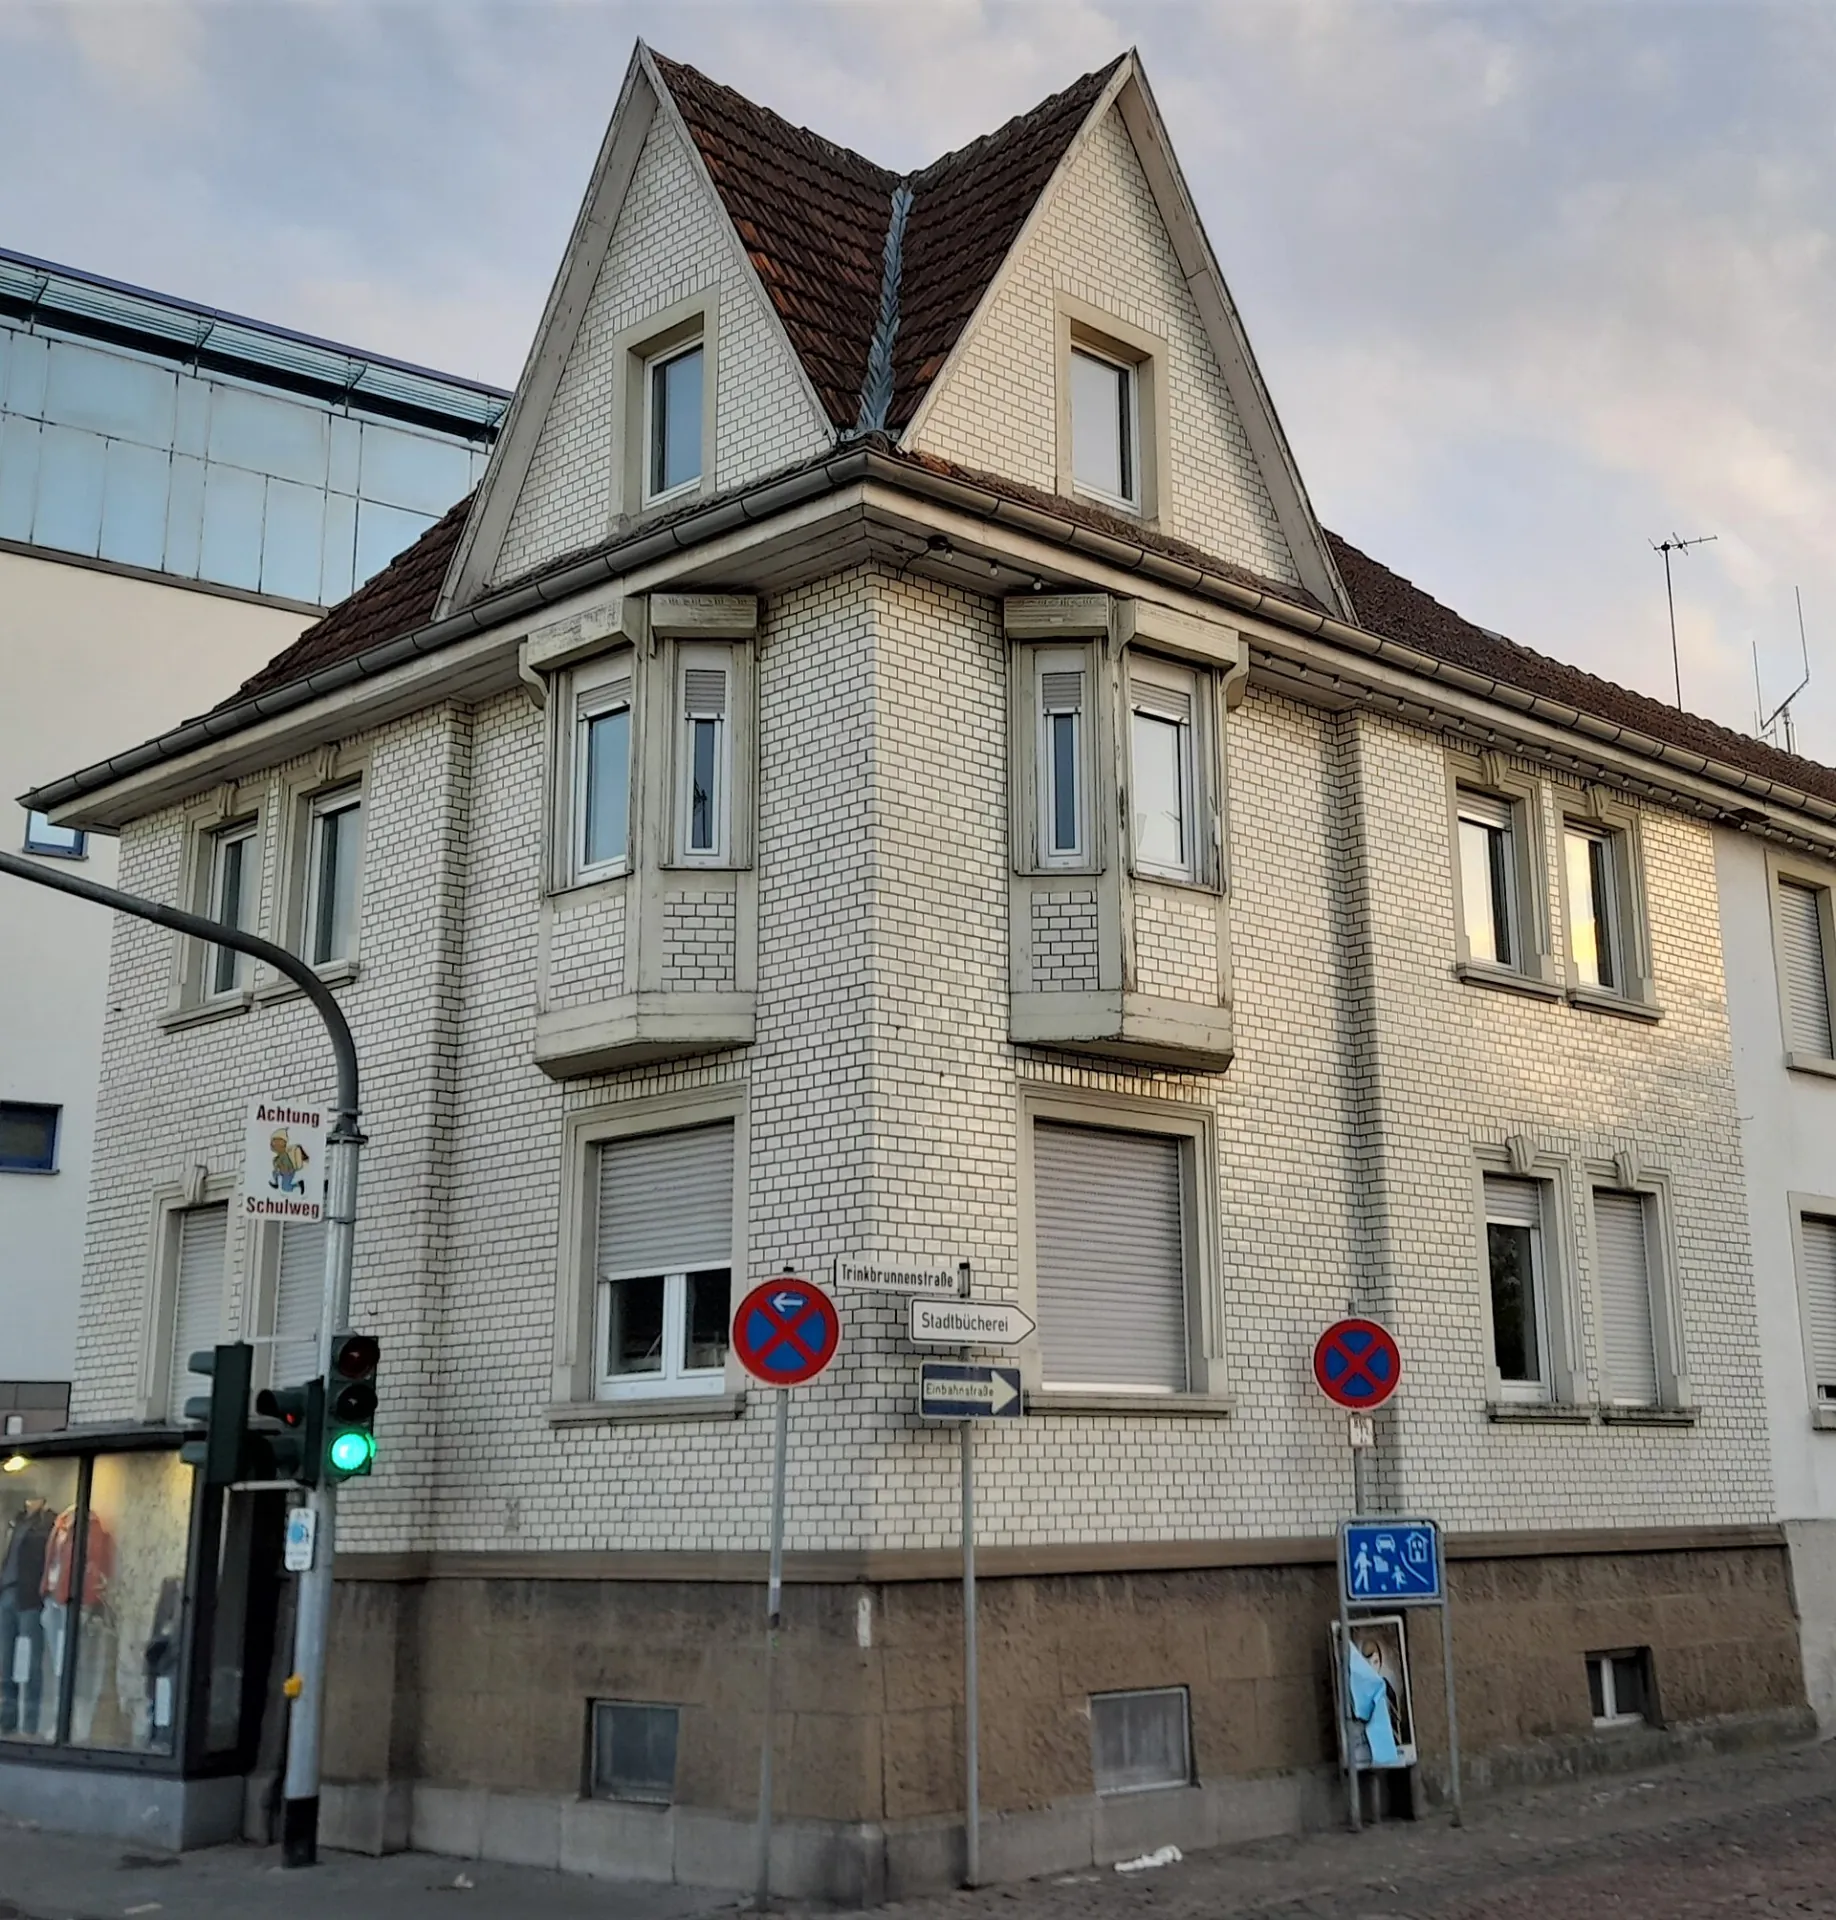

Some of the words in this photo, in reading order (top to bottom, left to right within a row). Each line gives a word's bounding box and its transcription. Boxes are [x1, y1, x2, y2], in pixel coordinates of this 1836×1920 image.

[257, 1105, 320, 1128] Achtung
[246, 1196, 320, 1219] Schulweg
[842, 1264, 953, 1288] Trinkbrunnenstraße
[922, 1312, 1009, 1332] Stadtbücherei
[926, 1383, 994, 1397] Einbahnstraße
